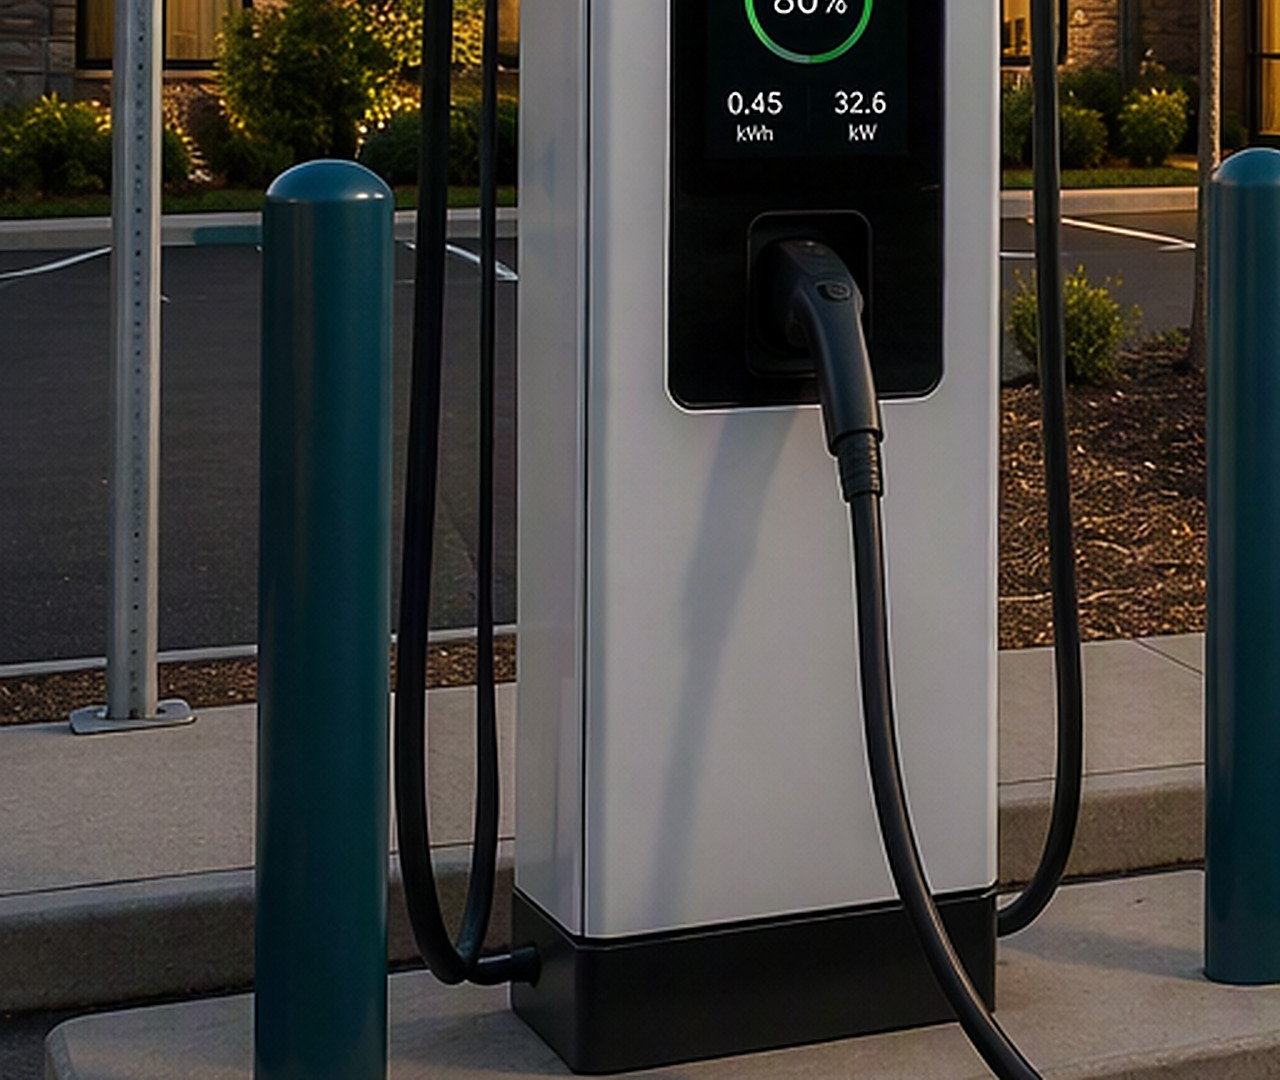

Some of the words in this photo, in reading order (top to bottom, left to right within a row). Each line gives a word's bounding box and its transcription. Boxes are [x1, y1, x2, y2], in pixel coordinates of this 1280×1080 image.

[727, 91, 783, 115] 0.45
[834, 90, 887, 115] 32.6
[736, 124, 774, 142] kWh
[848, 124, 877, 141] kW
